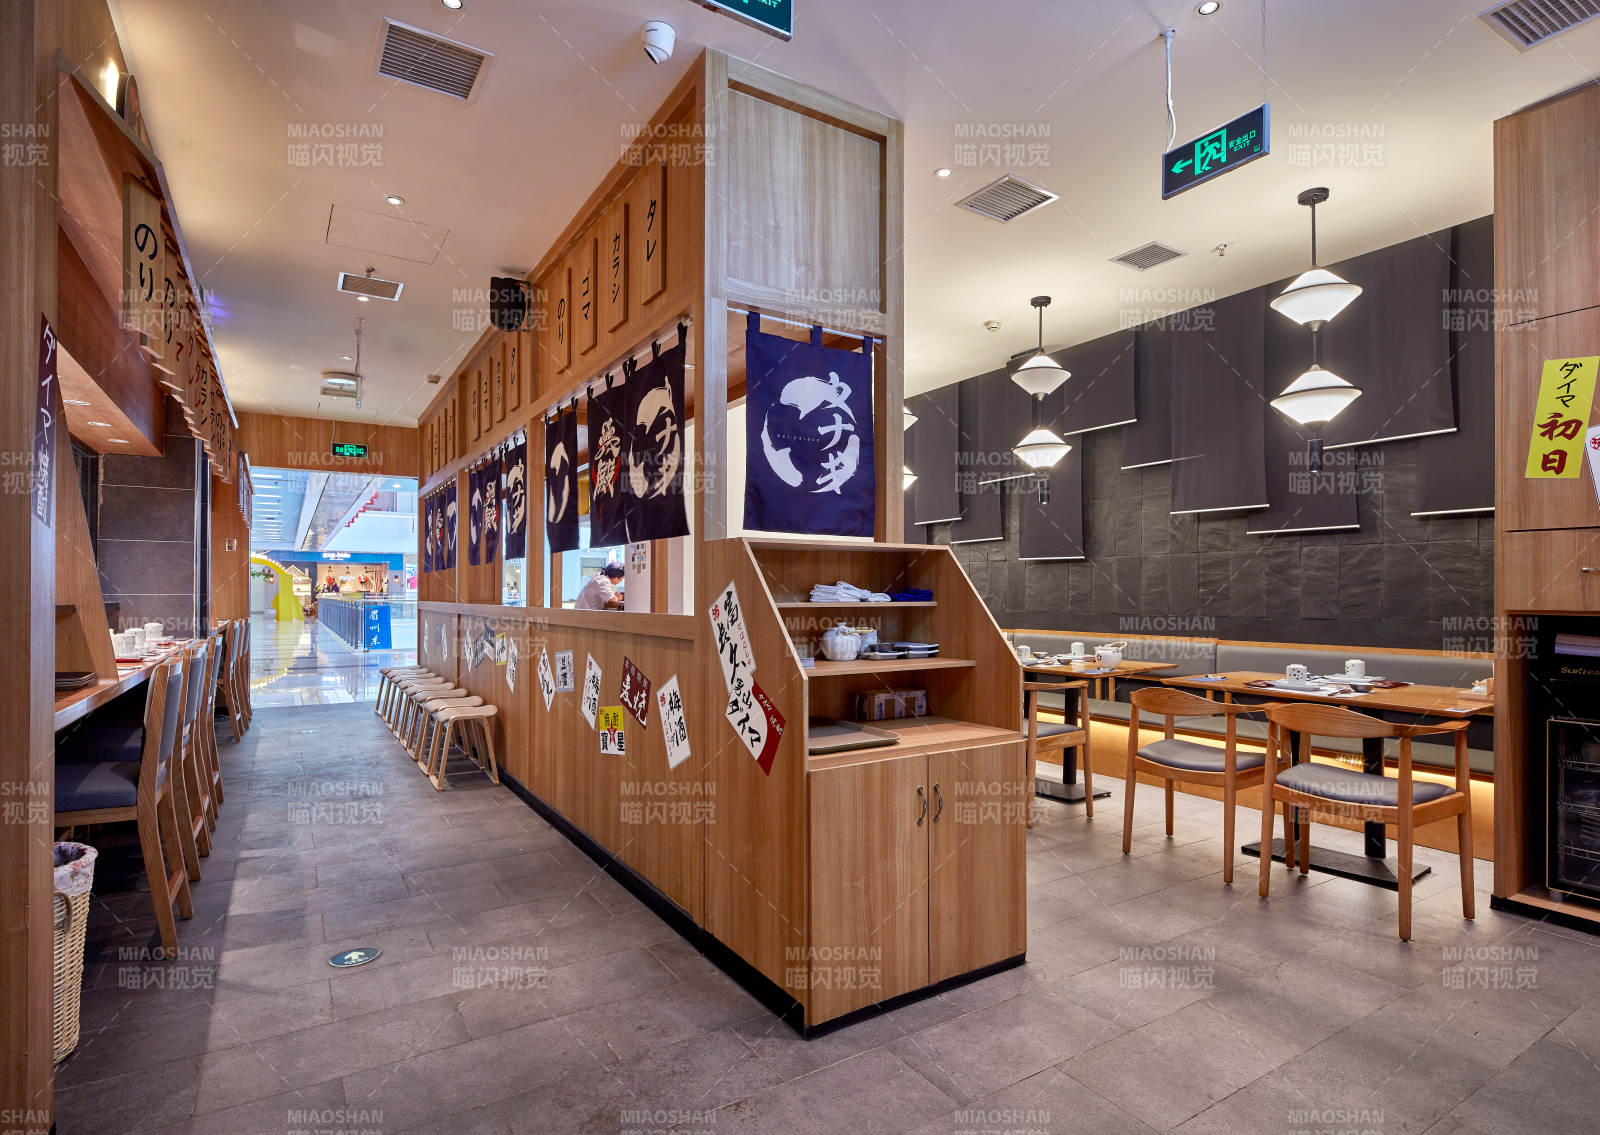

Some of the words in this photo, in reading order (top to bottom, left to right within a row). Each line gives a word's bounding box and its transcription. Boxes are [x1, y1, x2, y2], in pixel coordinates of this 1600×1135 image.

[1234, 140, 1251, 152] EXIT
[647, 199, 657, 262] タレ
[135, 223, 158, 302] のり
[612, 233, 621, 303] カラシ
[557, 298, 566, 344] のり
[582, 268, 591, 320] ゴマ
[1555, 362, 1583, 408] ダイマ
[1536, 412, 1584, 475] 初日
